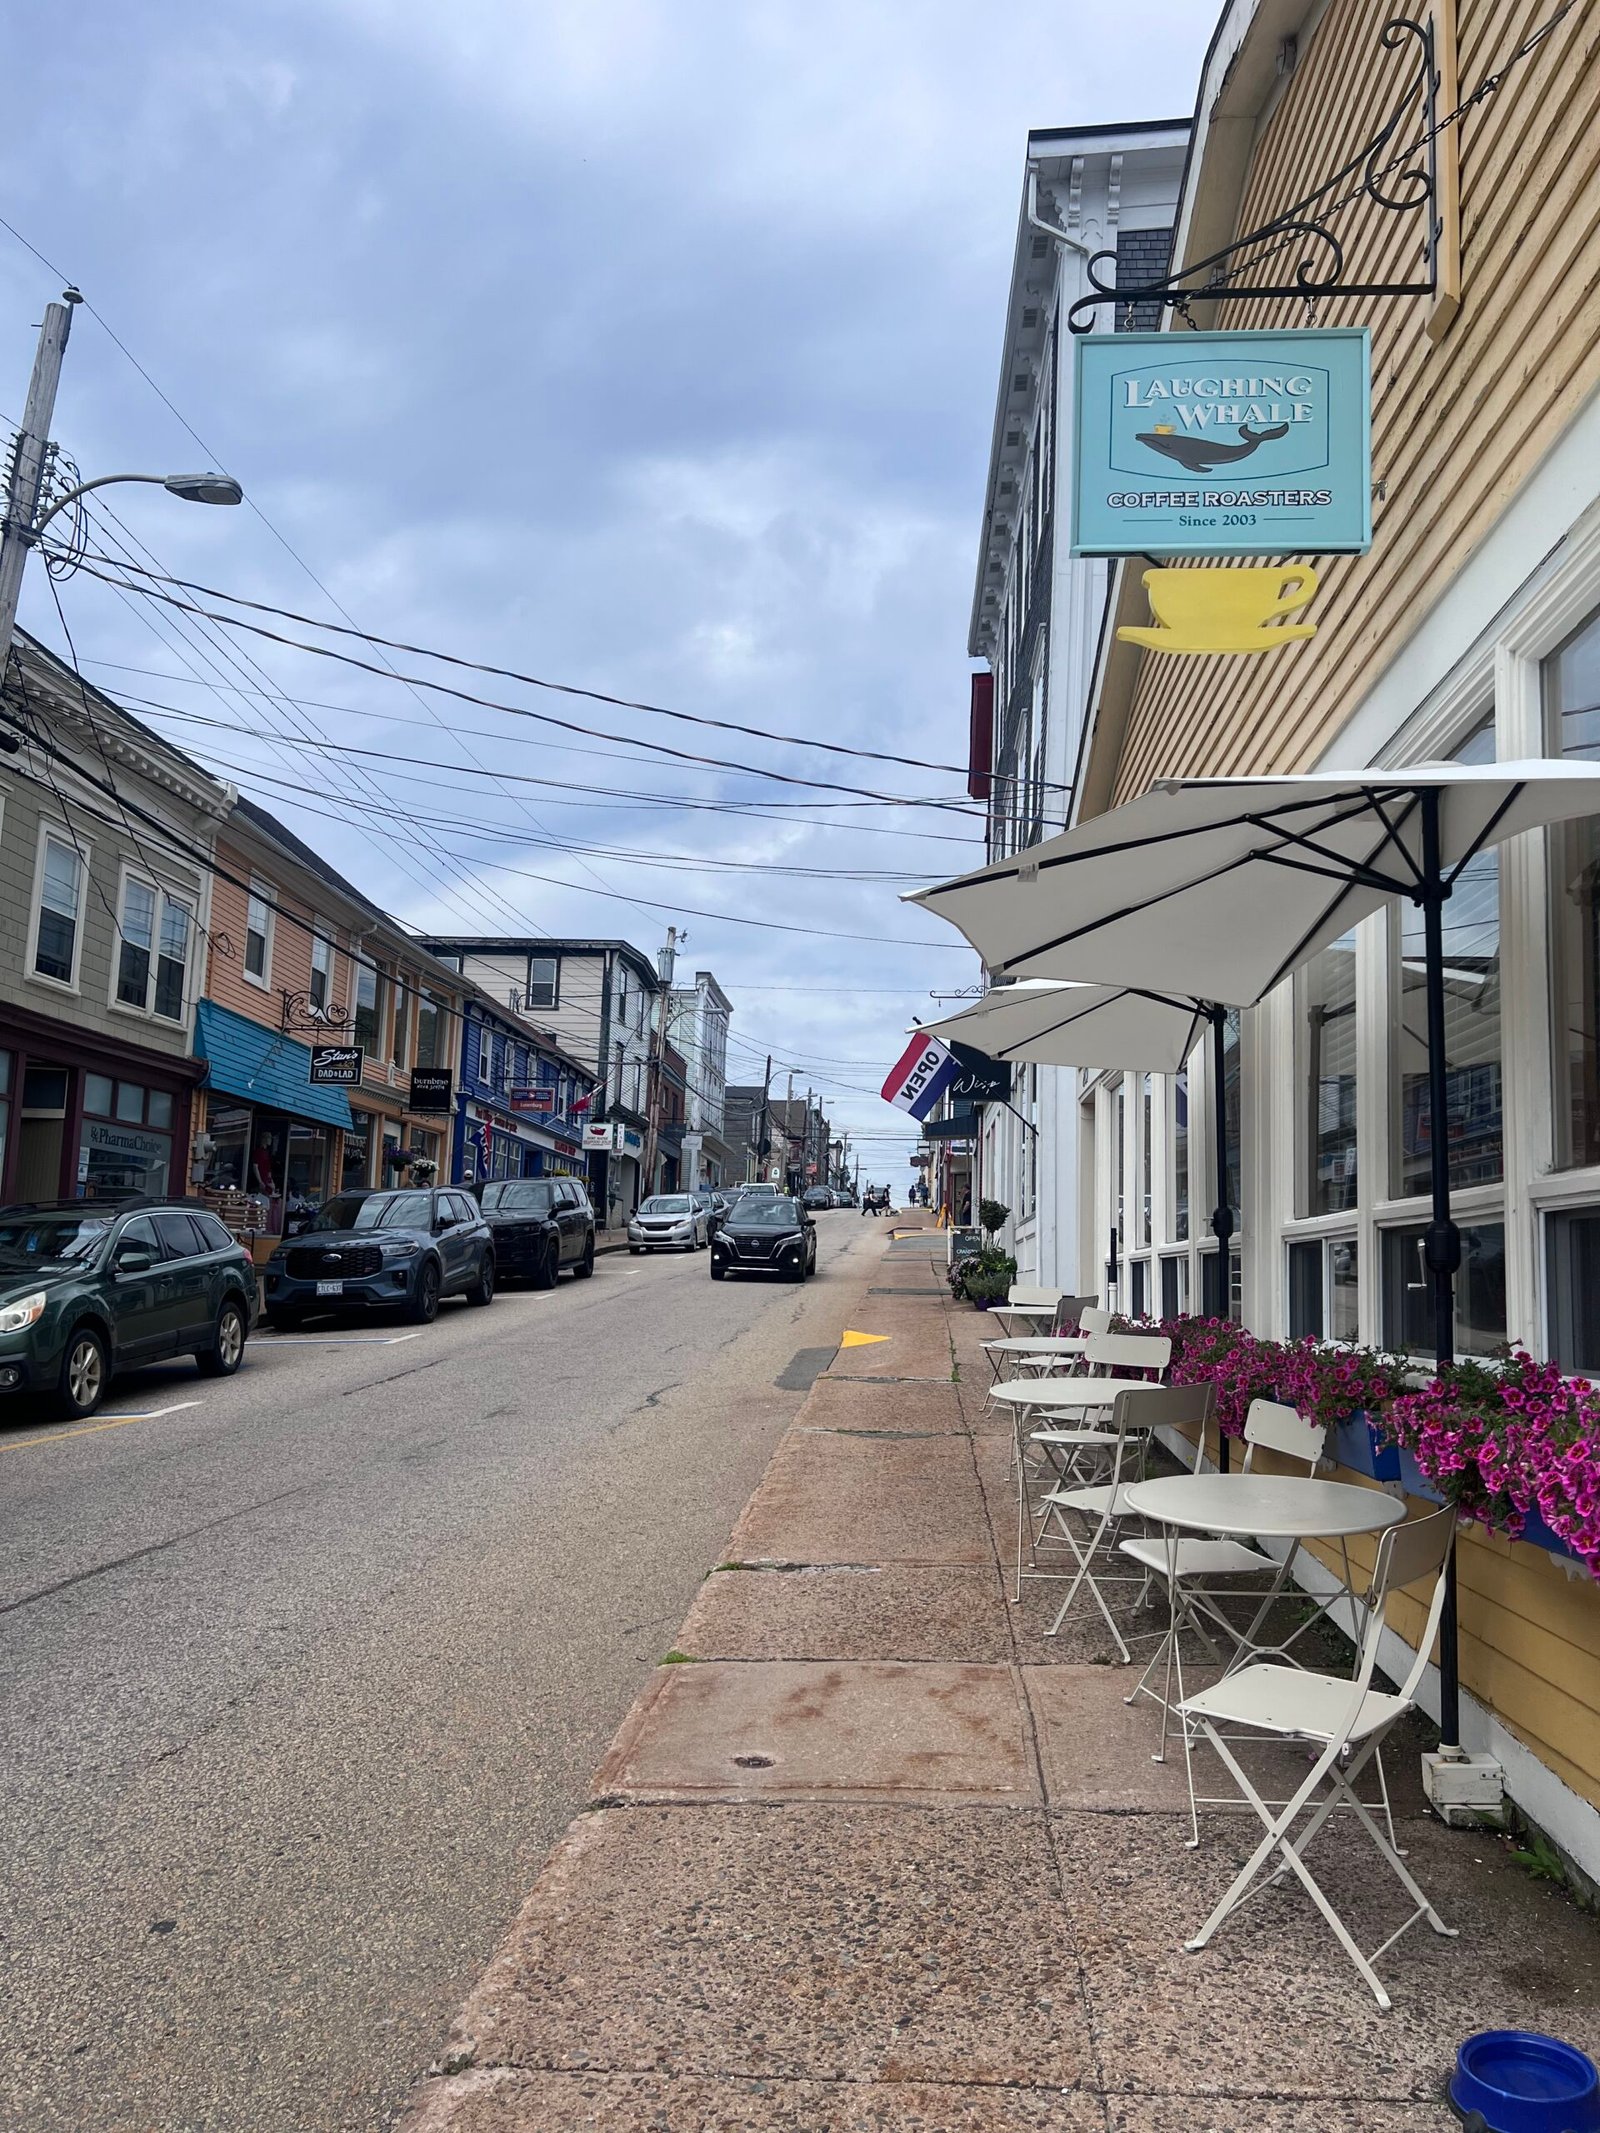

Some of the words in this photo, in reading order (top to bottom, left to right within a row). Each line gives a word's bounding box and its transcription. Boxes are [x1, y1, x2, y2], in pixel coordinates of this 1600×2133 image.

[1124, 376, 1313, 408] LAUGHING
[1174, 402, 1314, 430] WHALE
[1107, 491, 1199, 508] COFFEE
[1203, 489, 1332, 507] ROASTERS
[1179, 515, 1217, 526] Since
[1222, 514, 1257, 526] 2003
[313, 1049, 358, 1066] Stan's
[99, 1128, 162, 1152] PharmaChoice
